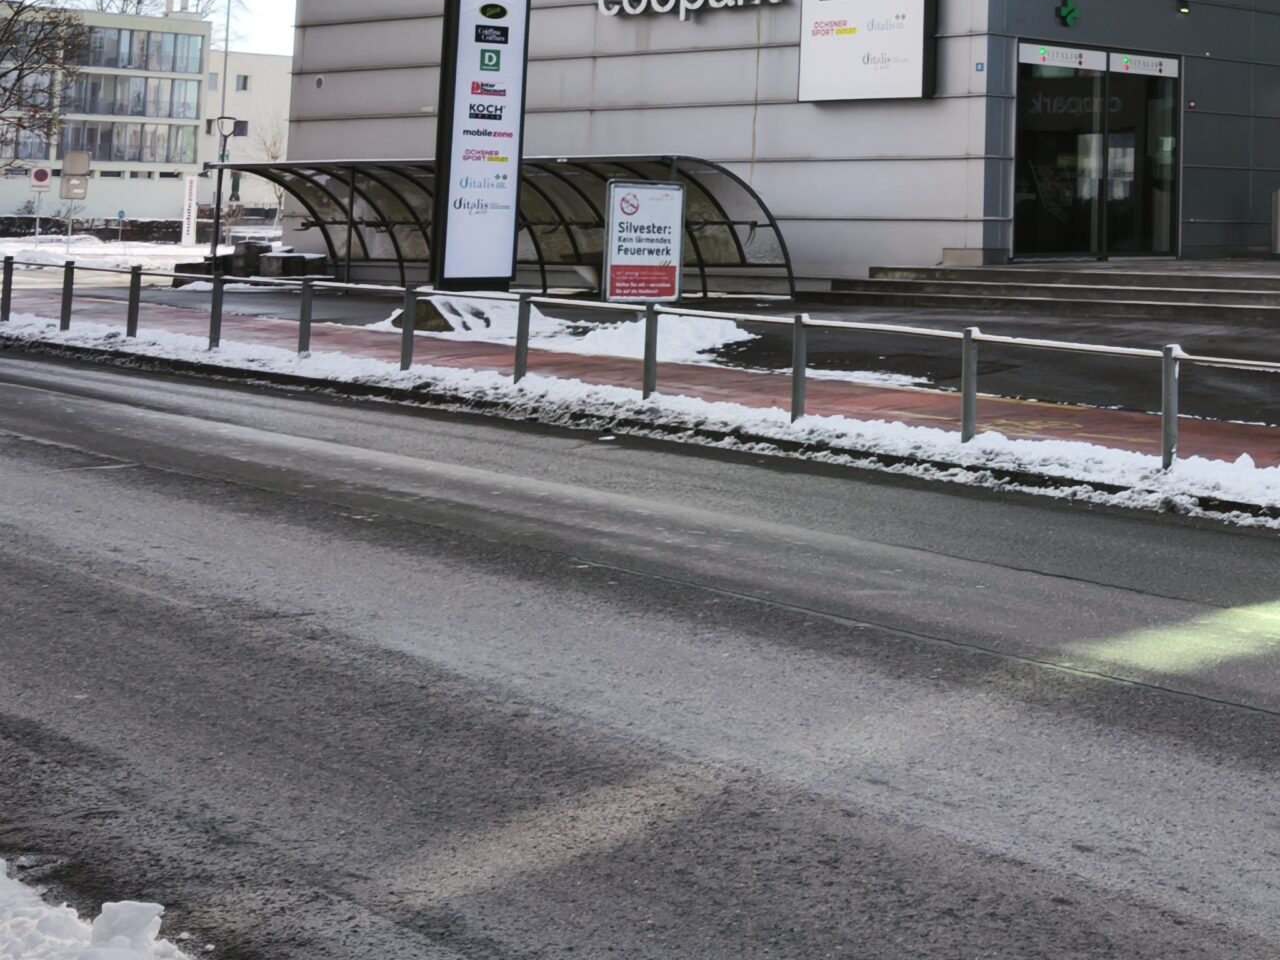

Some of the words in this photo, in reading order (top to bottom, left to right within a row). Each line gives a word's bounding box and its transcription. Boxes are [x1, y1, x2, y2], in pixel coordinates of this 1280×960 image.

[469, 103, 503, 114] KOCH
[463, 128, 514, 138] mobilezone
[618, 221, 672, 235] Silvester:
[617, 244, 672, 256] Feuerwerk
